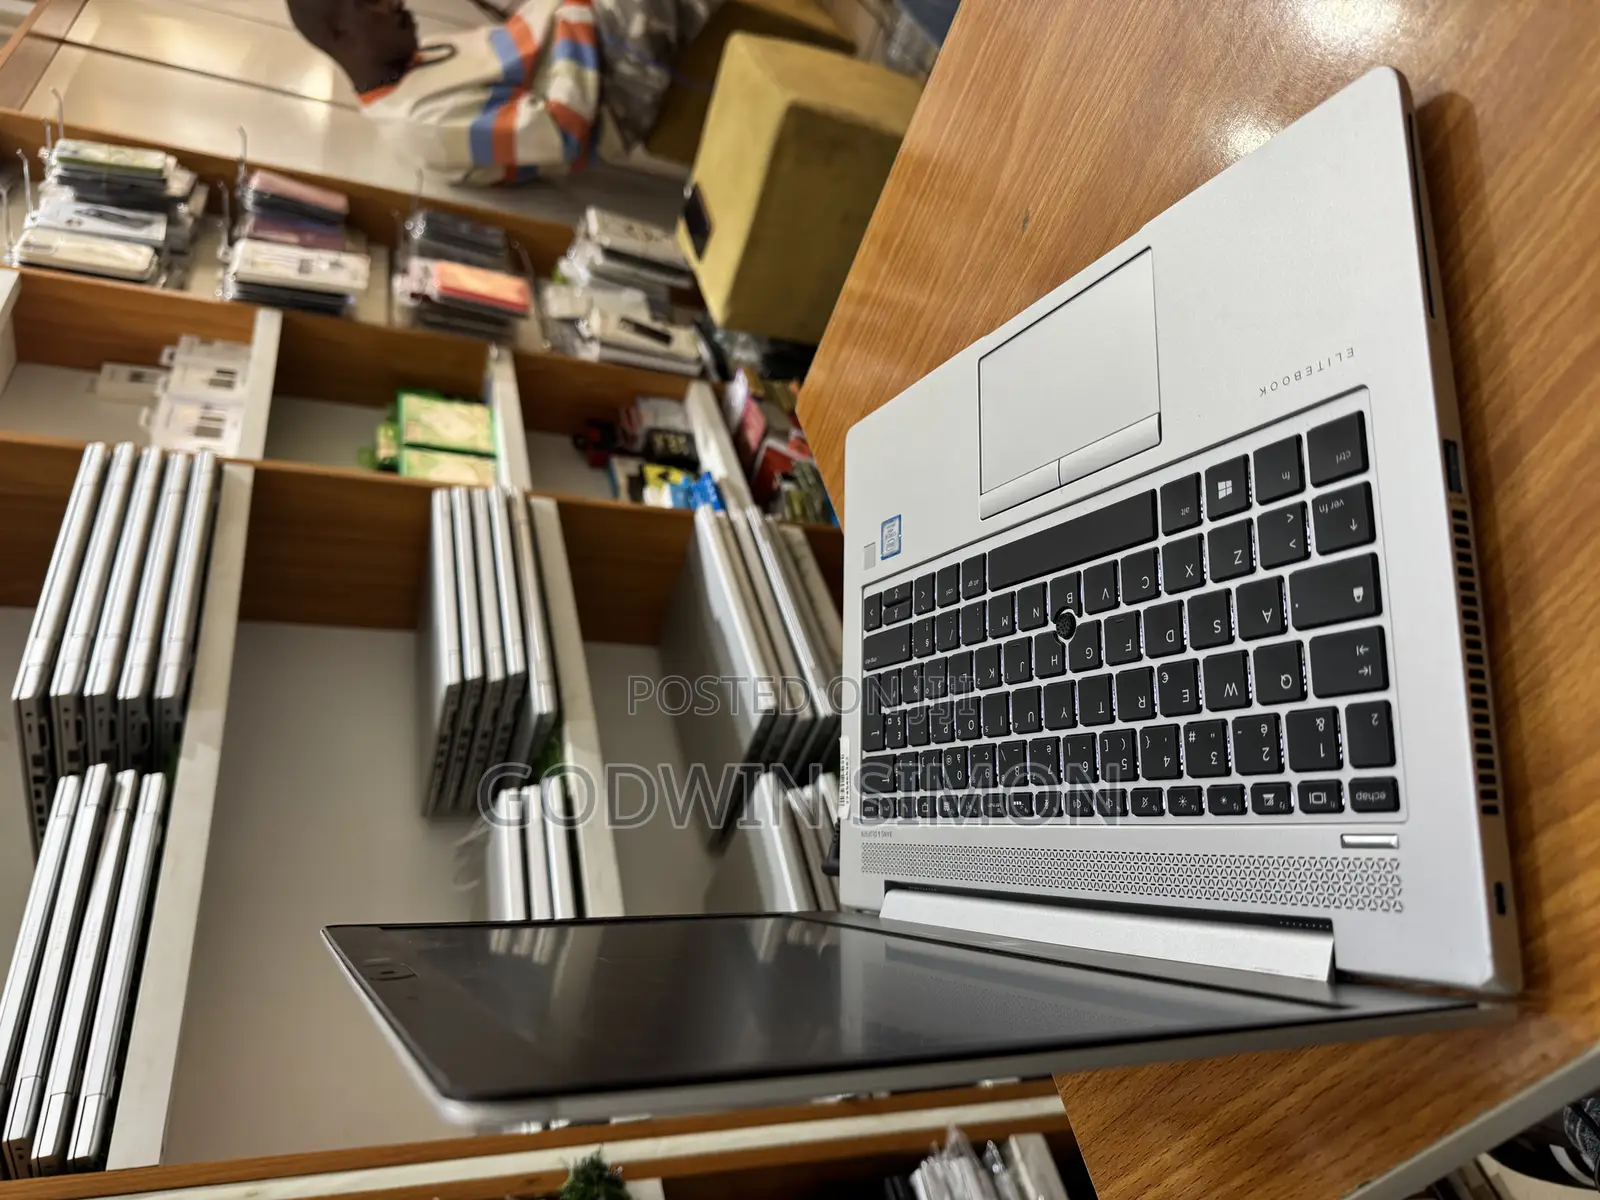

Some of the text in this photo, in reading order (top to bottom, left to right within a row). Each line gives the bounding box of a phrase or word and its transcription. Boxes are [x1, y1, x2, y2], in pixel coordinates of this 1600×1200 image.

[1259, 347, 1354, 397] ELITEBOOK
[1336, 451, 1351, 464] ctrl
[1282, 472, 1290, 480] fn
[1181, 507, 1190, 516] alt
[1319, 500, 1344, 513] ver fn
[1287, 514, 1294, 523] <
[1289, 539, 1296, 548] >
[1234, 550, 1242, 565] Z
[1185, 564, 1194, 578] X
[1142, 576, 1150, 589] C
[1066, 592, 1073, 604] B
[1102, 588, 1109, 600] V
[1033, 607, 1039, 618] N
[1262, 608, 1272, 624] A
[1002, 616, 1008, 626] M
[1214, 620, 1221, 633] S
[1166, 629, 1174, 642] D
[1125, 639, 1132, 652] F
[1086, 647, 1093, 659] G
[1051, 654, 1058, 666] H
[1020, 661, 1024, 672] J
[989, 668, 994, 678] K
[1162, 672, 1169, 683] €
[1280, 674, 1292, 689] Q
[1182, 689, 1189, 702] E
[1224, 682, 1238, 697] W
[1098, 702, 1104, 714] T
[1138, 696, 1146, 708] R
[1028, 712, 1034, 722] U
[1061, 707, 1068, 718] Y
[968, 720, 974, 730] O
[1316, 718, 1325, 732] &
[1372, 713, 1378, 725] 2
[943, 722, 948, 733] P
[1261, 724, 1268, 736] é
[1188, 731, 1196, 742] #
[1104, 739, 1108, 752] [
[1121, 738, 1126, 750] (
[1262, 747, 1270, 761] 2
[1320, 743, 1325, 758] 1
[1122, 758, 1127, 770] 5
[1164, 756, 1170, 767] 4
[1211, 752, 1217, 764] 3
[1015, 766, 1020, 777] 8
[1048, 764, 1052, 775] 7
[1083, 761, 1088, 772] 6
[957, 770, 962, 780] 0
[985, 768, 990, 778] 9
[1356, 792, 1386, 801] echap
